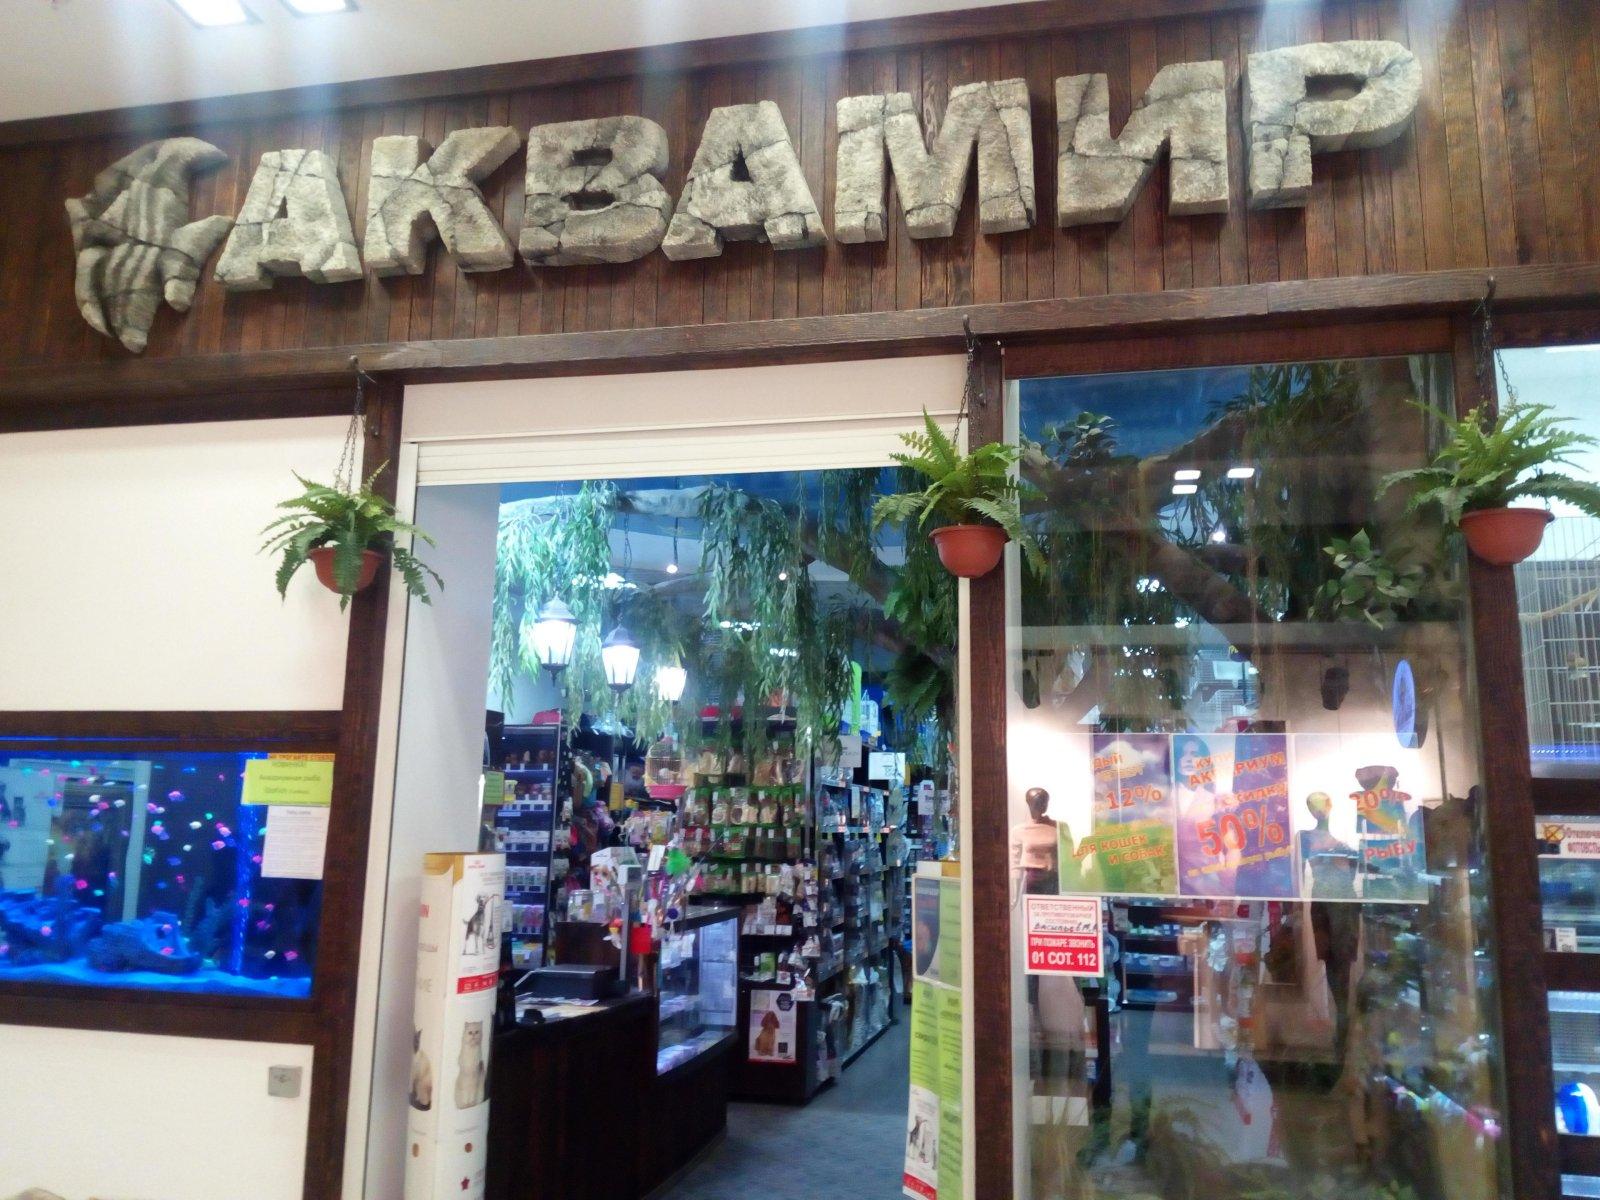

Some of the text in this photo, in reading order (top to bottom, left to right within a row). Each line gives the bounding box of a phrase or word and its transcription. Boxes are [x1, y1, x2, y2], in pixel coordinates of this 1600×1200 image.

[214, 39, 1423, 288] АКВАМИР
[1189, 752, 1286, 787] АКРИУМ
[1195, 804, 1284, 857] 50%
[1101, 834, 1148, 851] КОШЕК
[1365, 840, 1417, 860] РЫБУ
[1108, 852, 1120, 865] И
[1031, 951, 1096, 967] 01 СОТ. 112
